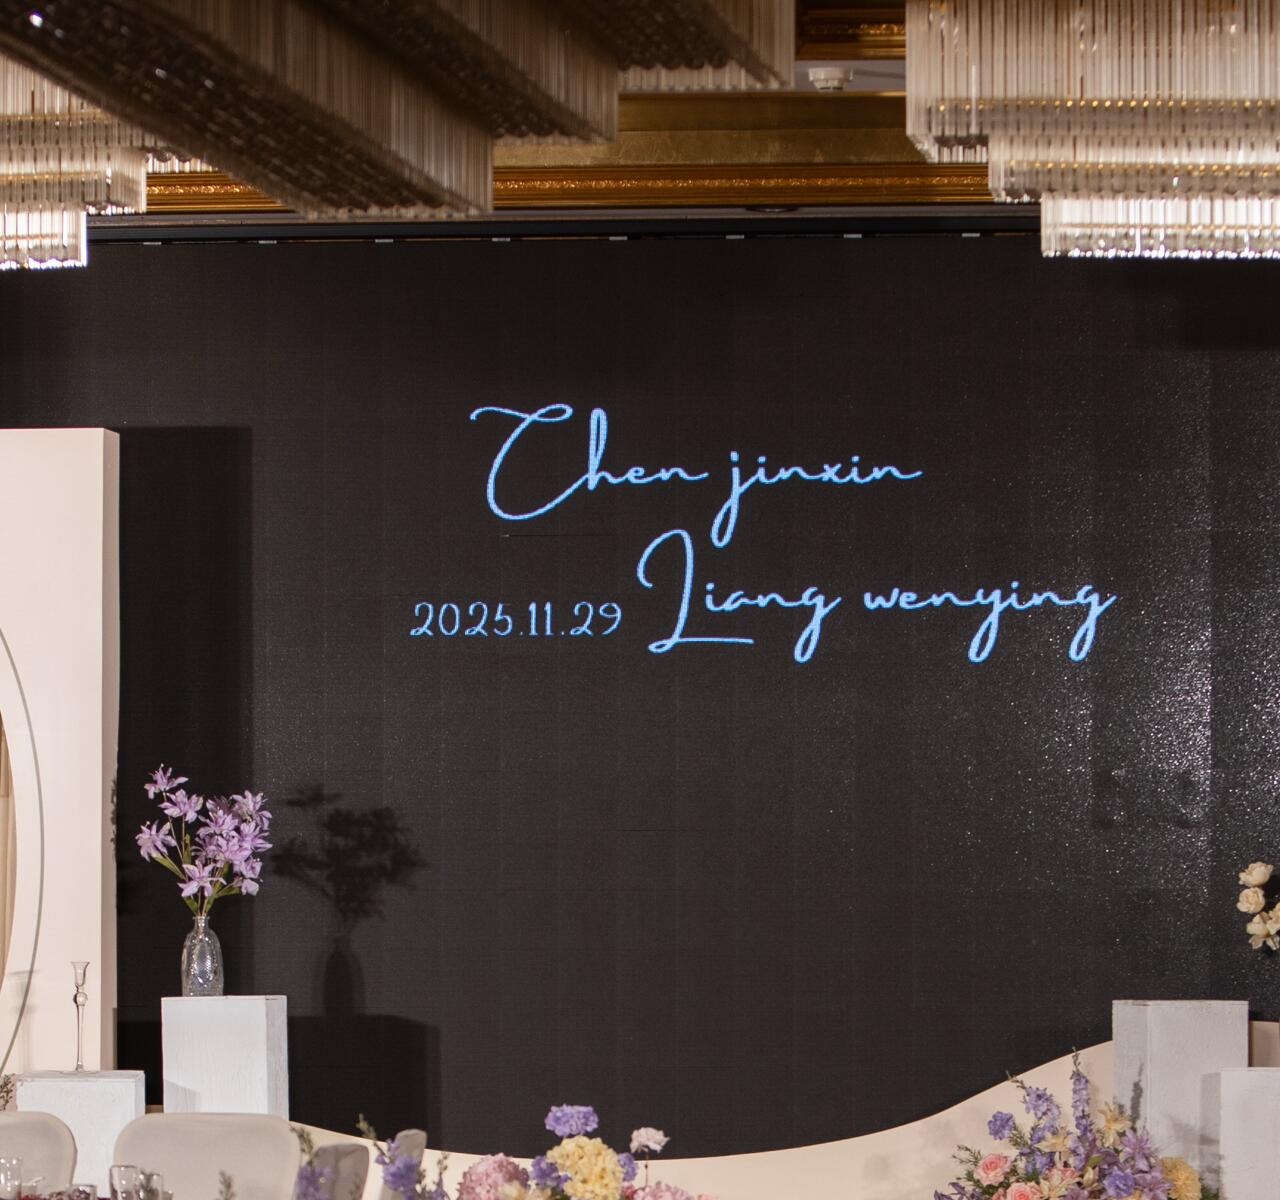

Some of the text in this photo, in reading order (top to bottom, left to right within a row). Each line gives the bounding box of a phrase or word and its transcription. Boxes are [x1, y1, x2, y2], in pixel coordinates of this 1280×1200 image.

[470, 403, 923, 549] Chen jinxin
[410, 601, 623, 637] 2025.11.29
[637, 529, 1118, 665] Liang wenying
